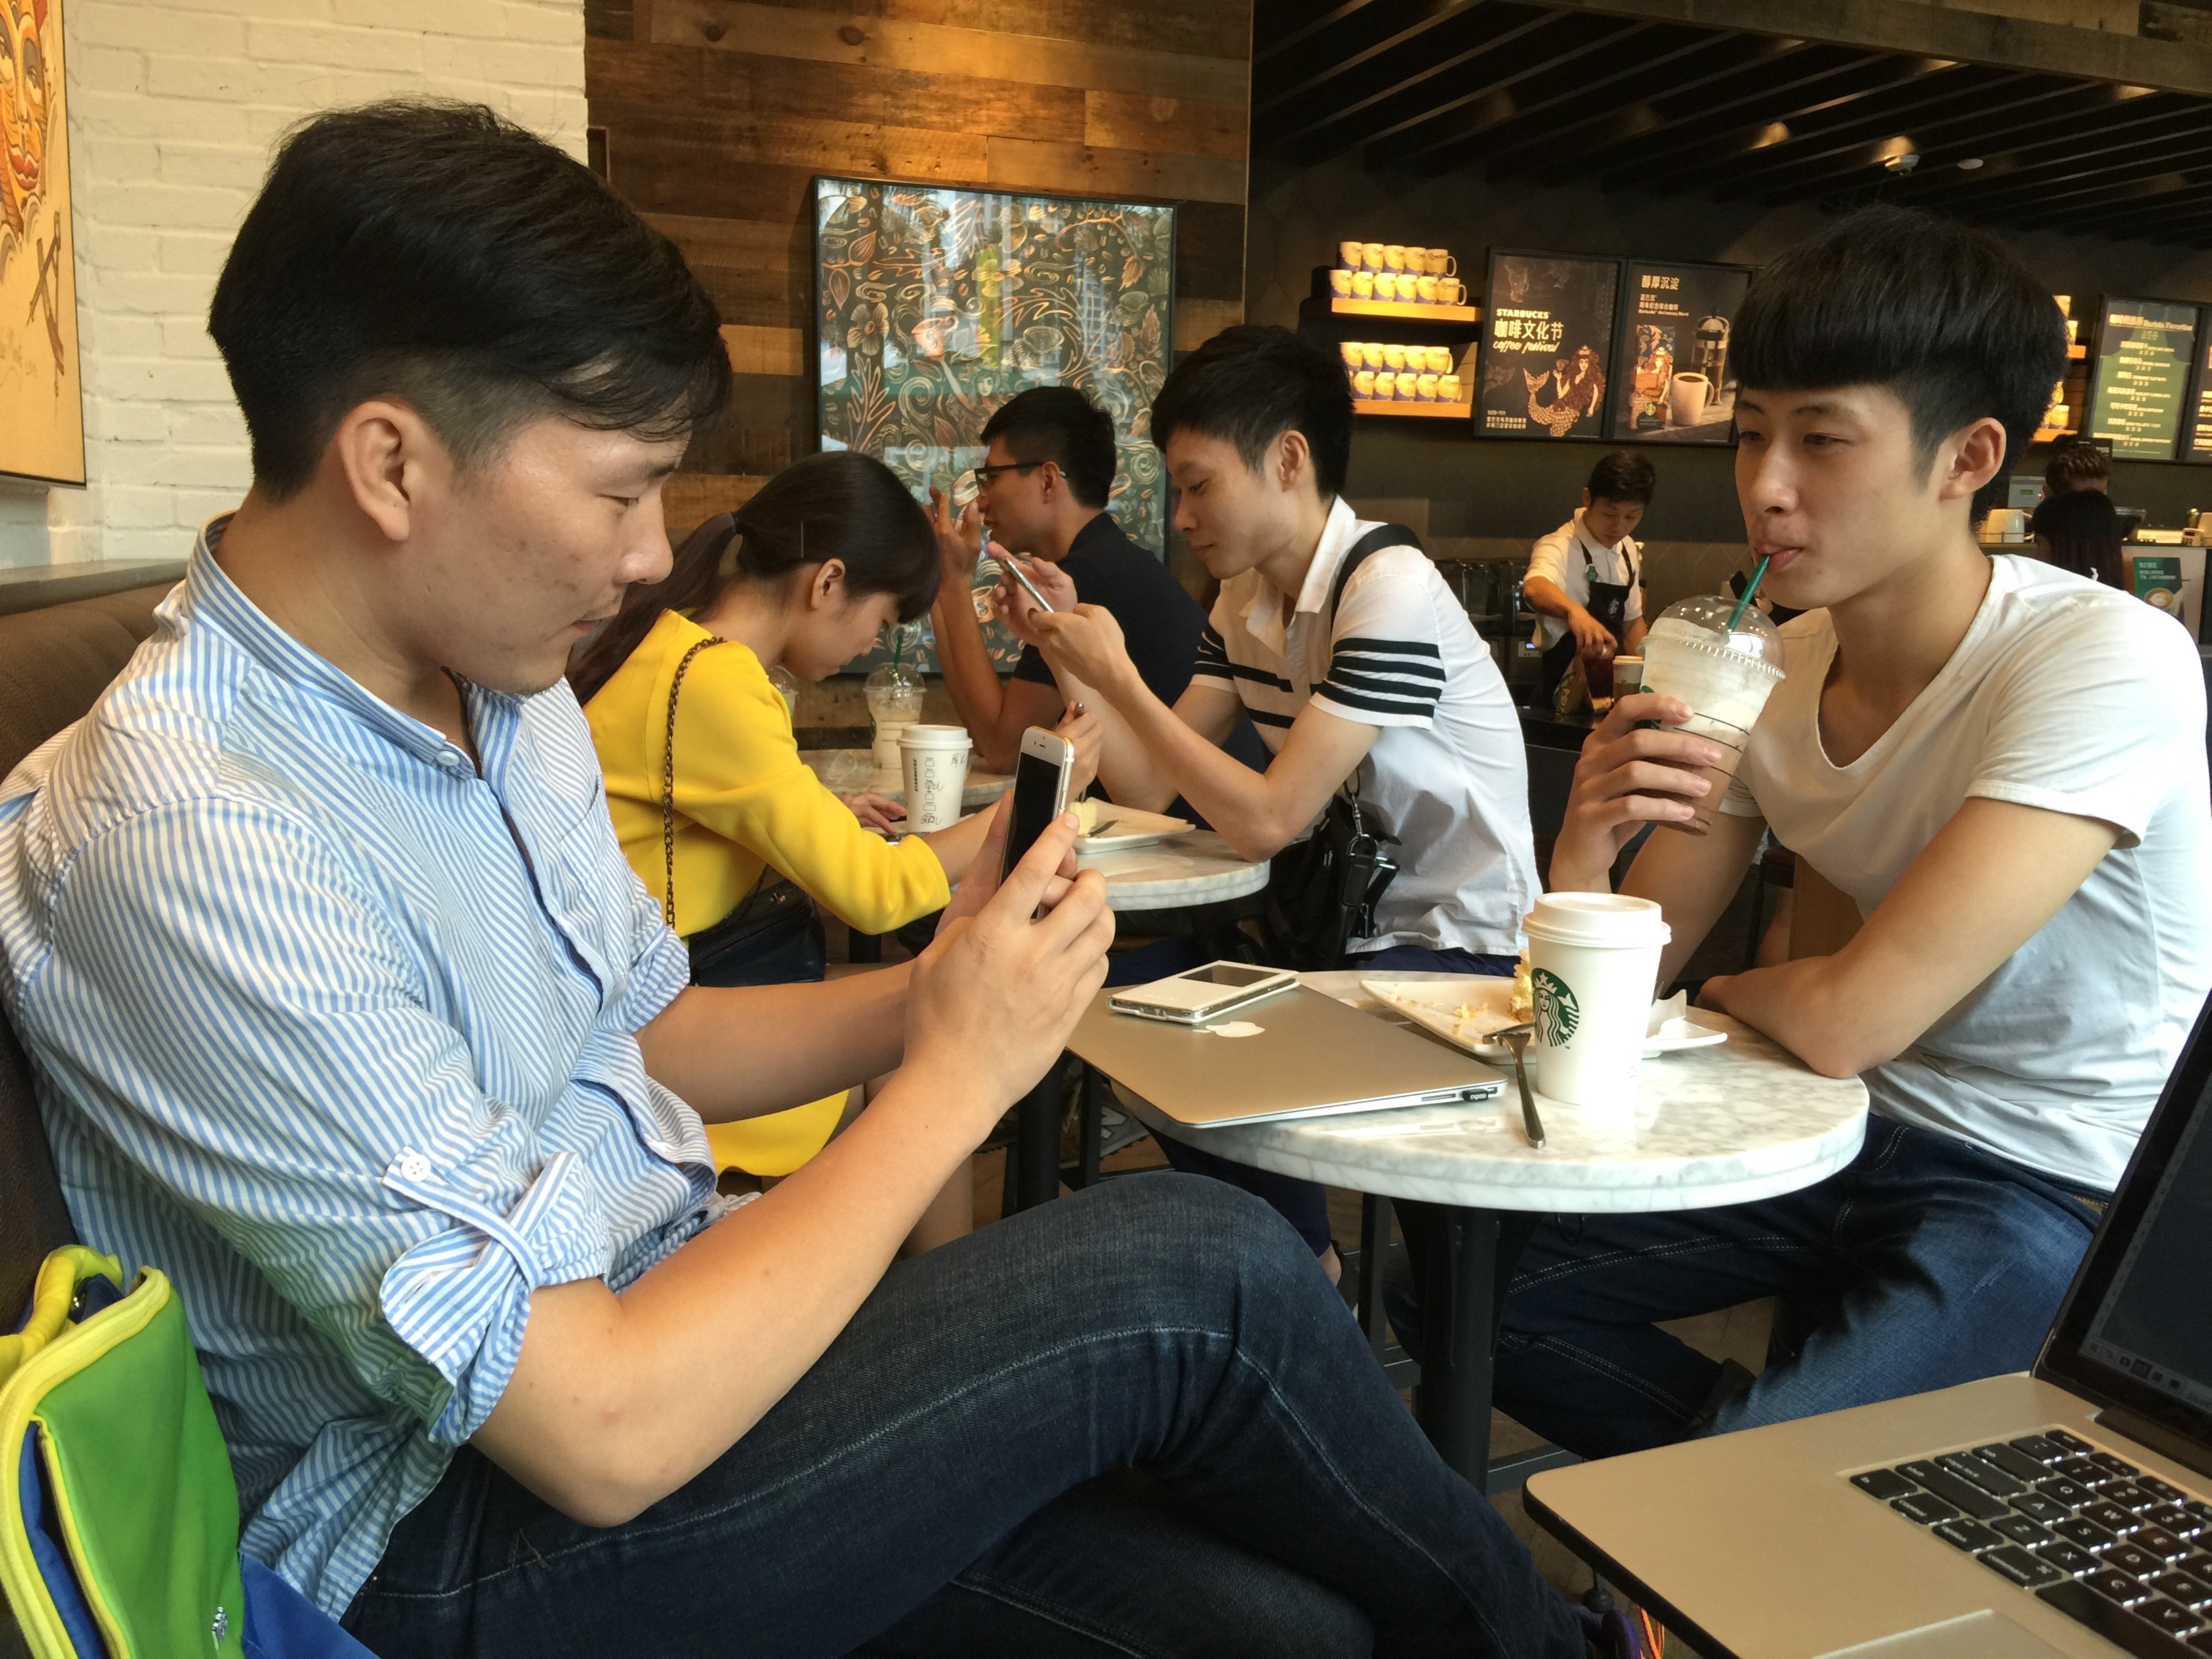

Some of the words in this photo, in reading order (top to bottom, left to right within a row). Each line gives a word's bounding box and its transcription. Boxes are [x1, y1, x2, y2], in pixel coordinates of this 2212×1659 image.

[1496, 308, 1550, 319] STARBUCKS
[1494, 318, 1564, 341] 咖啡文化节
[1492, 340, 1522, 353] coffee
[1521, 341, 1560, 354] festival
